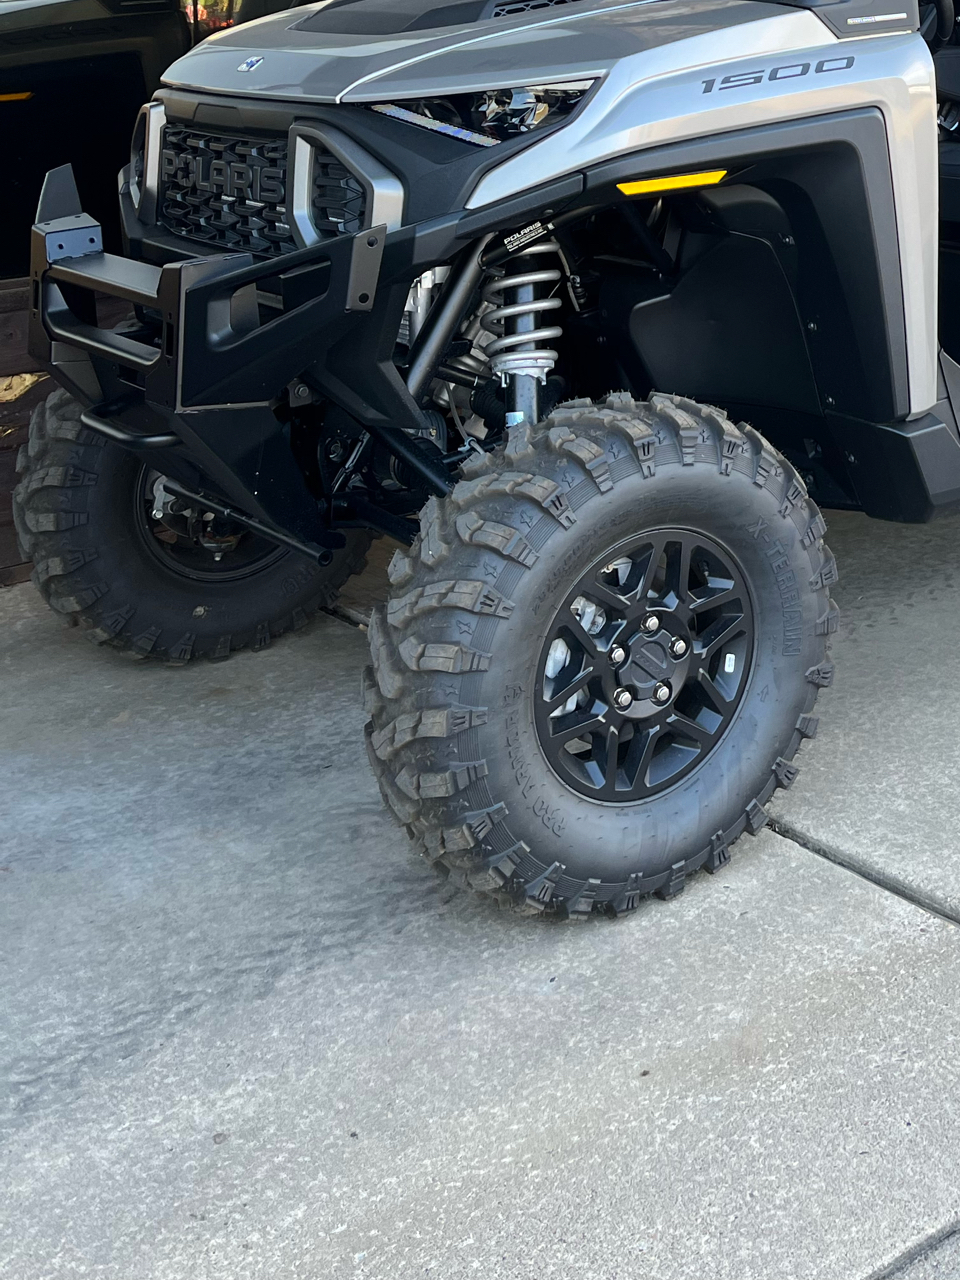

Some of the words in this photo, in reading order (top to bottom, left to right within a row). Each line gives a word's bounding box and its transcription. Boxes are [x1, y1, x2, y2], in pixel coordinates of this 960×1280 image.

[701, 56, 856, 94] 1500
[160, 148, 285, 205] POLARIS
[504, 221, 541, 244] POLARIS
[745, 514, 803, 657] X-TERRAIN
